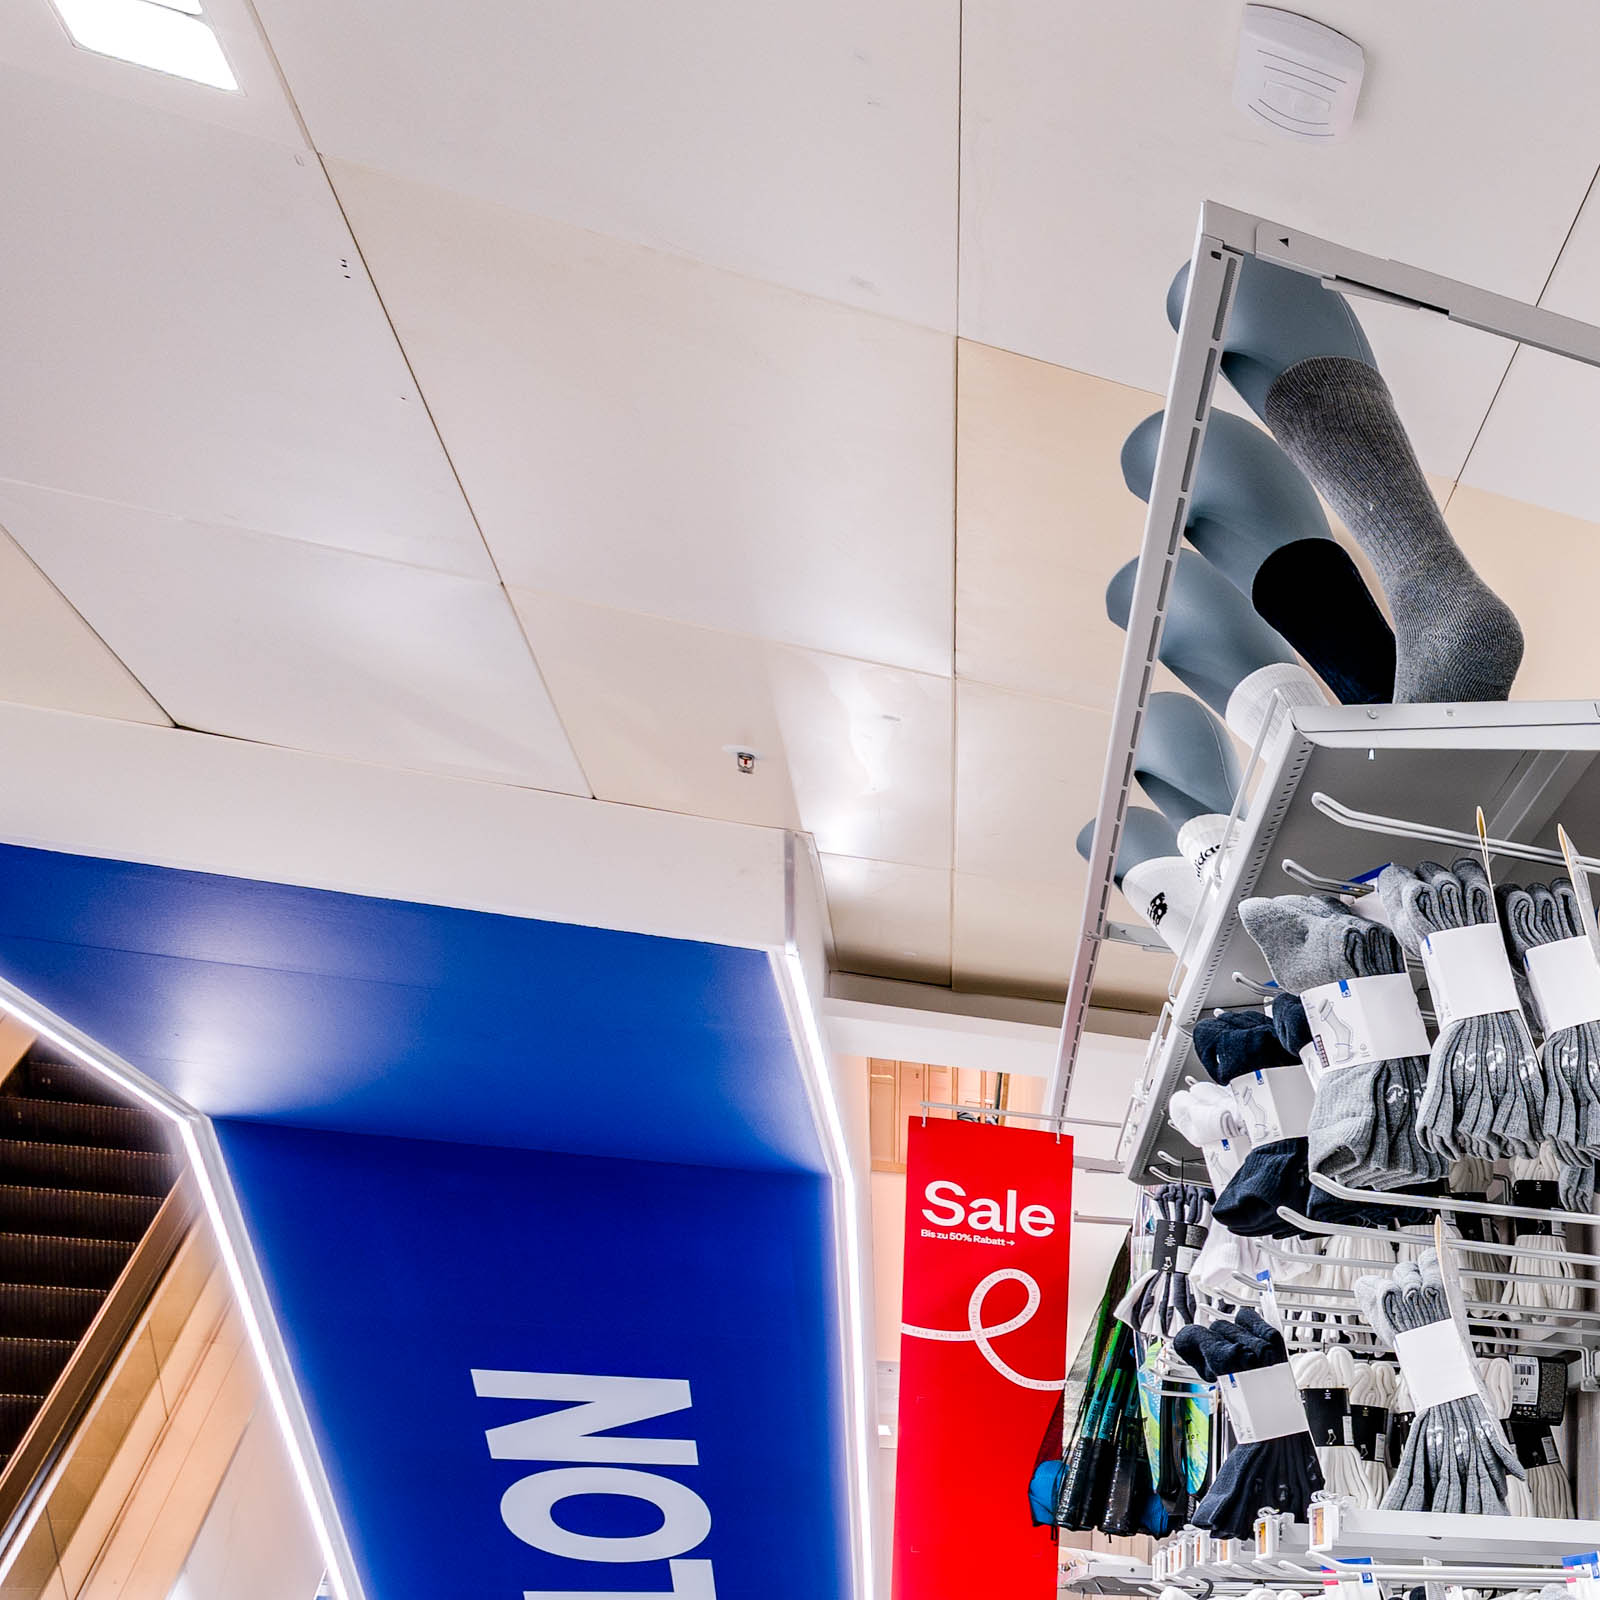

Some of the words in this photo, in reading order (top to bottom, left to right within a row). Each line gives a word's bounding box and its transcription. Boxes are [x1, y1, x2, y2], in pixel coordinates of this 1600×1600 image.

[921, 1180, 1055, 1237] Sale
[920, 1229, 936, 1238] Bis
[937, 1232, 949, 1240] zu
[949, 1233, 972, 1243] 50%
[973, 1235, 1006, 1246] Rabatt
